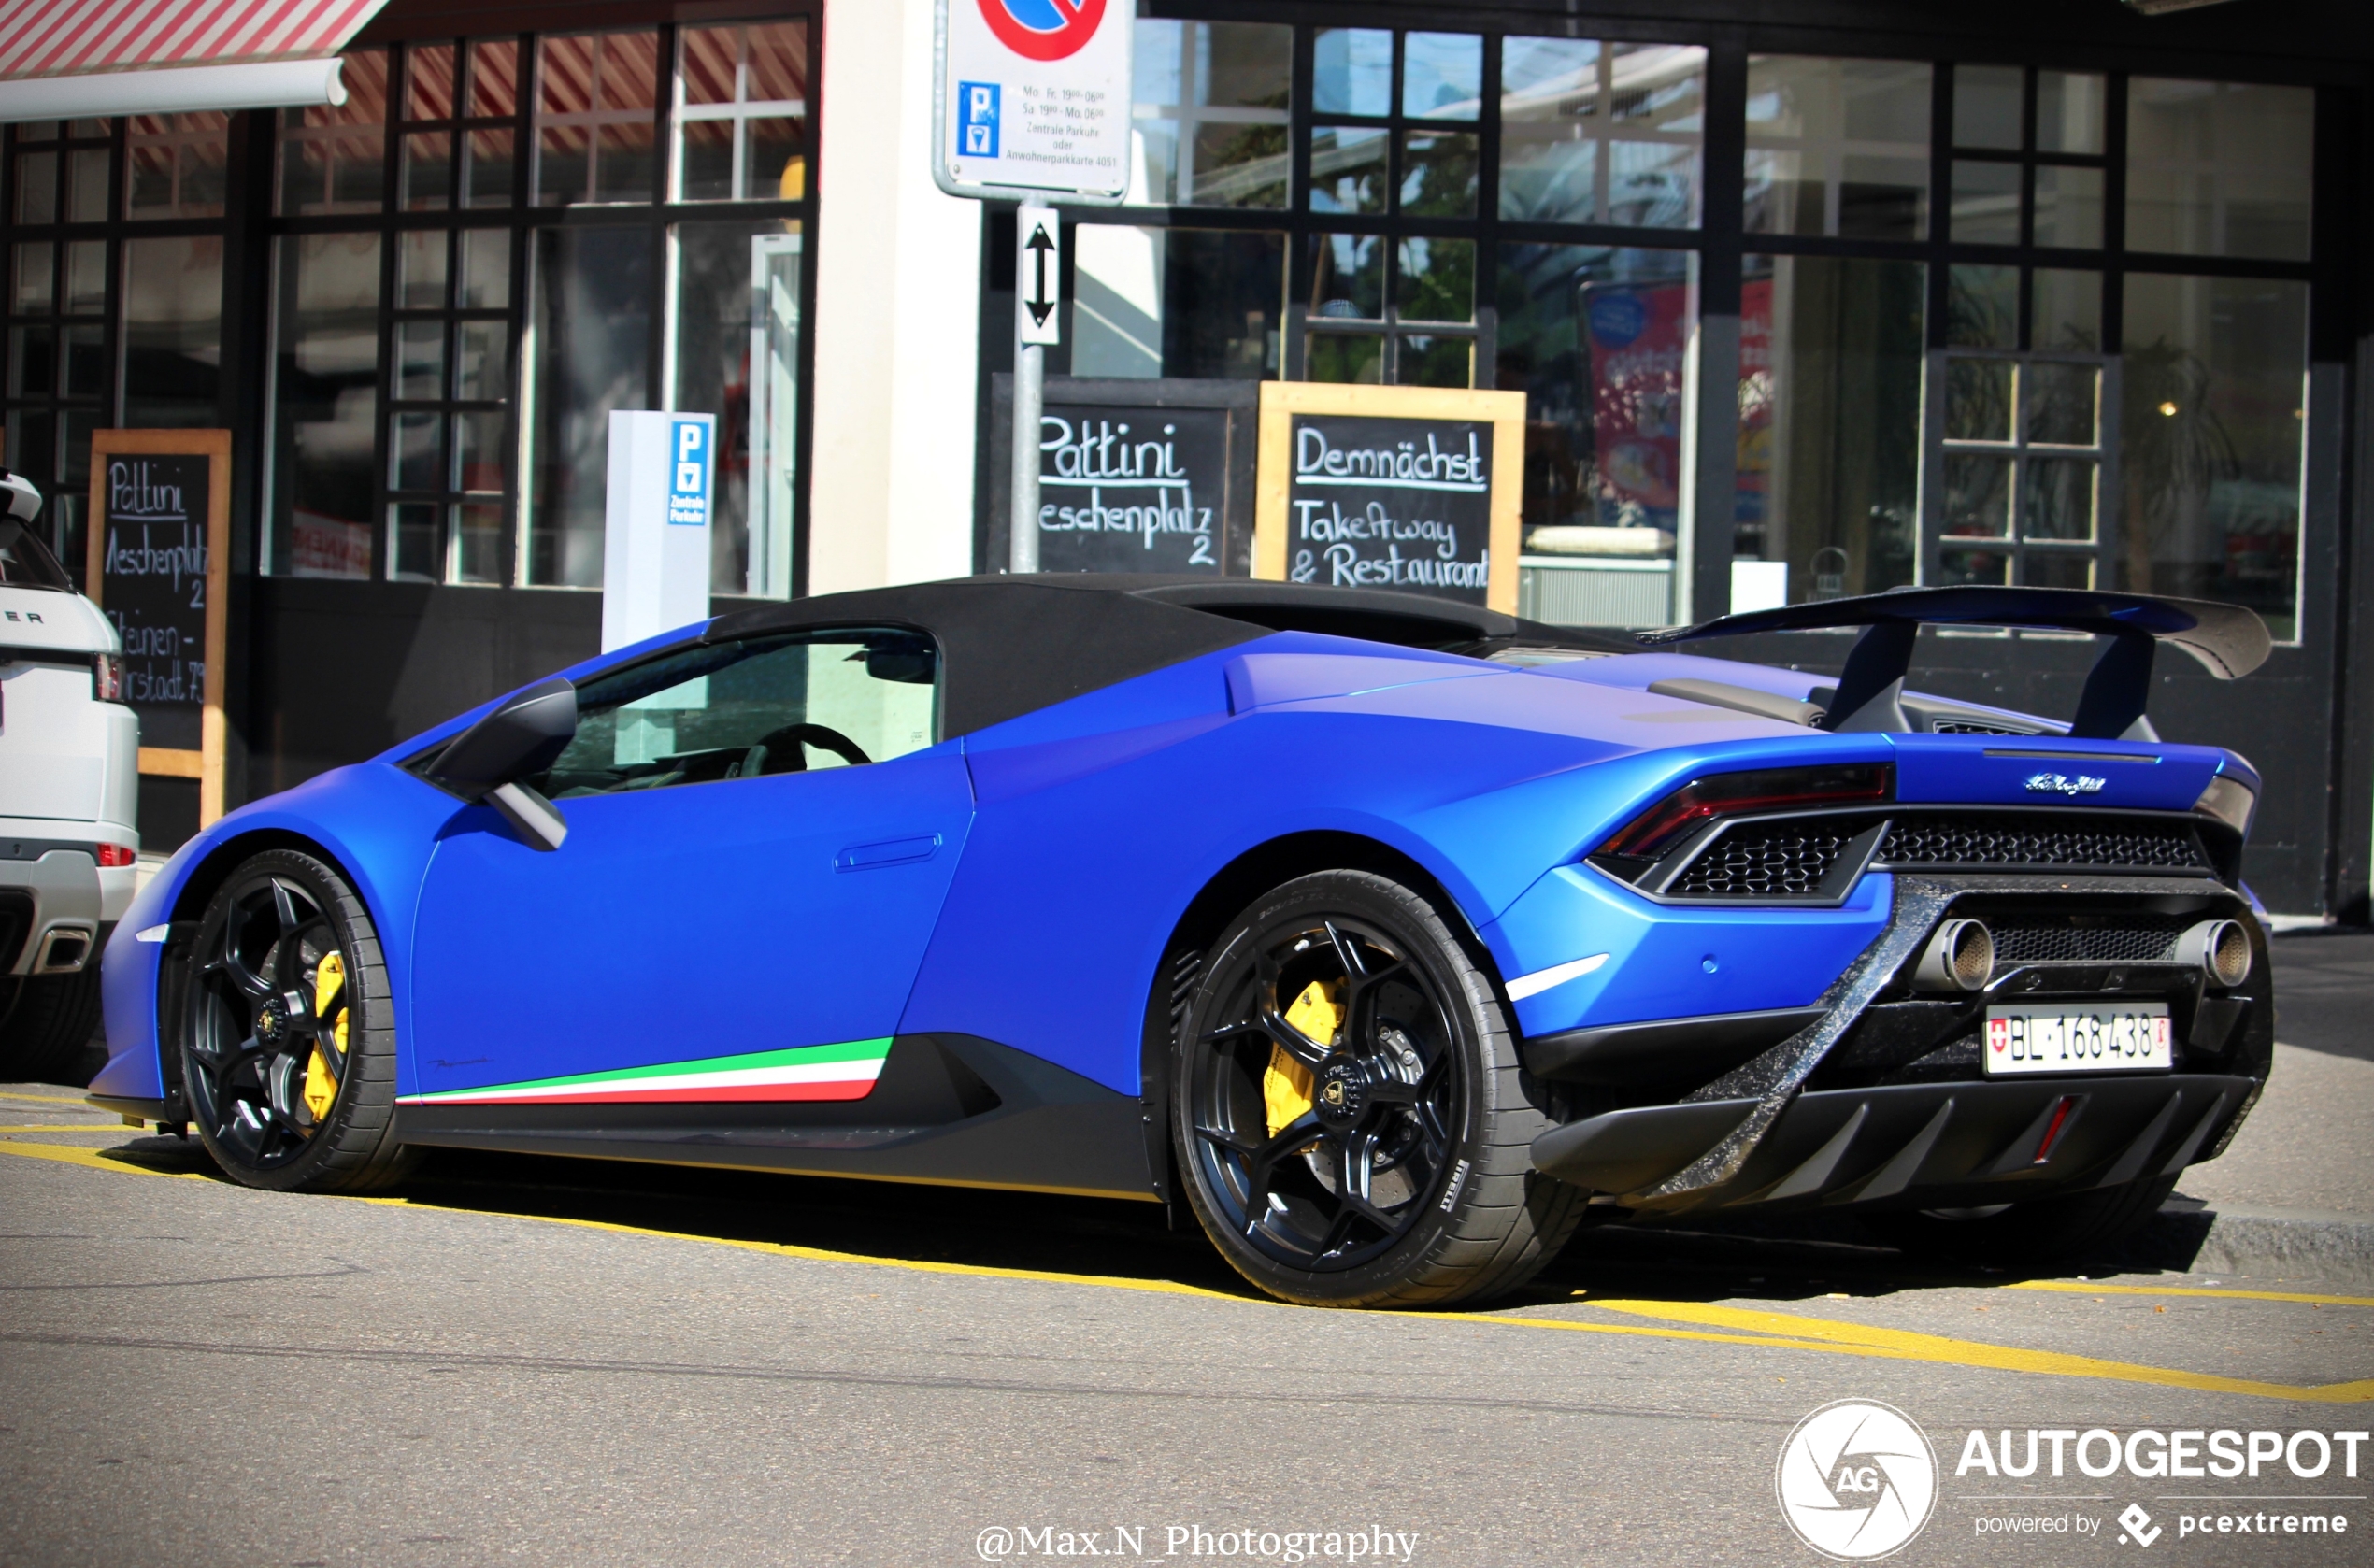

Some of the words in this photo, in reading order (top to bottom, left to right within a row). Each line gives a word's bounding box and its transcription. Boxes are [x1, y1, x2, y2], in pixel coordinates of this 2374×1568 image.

[970, 86, 991, 123] P
[1026, 121, 1064, 135] Zentrale
[1065, 125, 1099, 138] Parkuhr
[1052, 139, 1073, 150] oder
[1006, 150, 1094, 166] Anwohnerparkkarte
[1095, 156, 1117, 167] 4051
[679, 423, 702, 463] P
[1039, 416, 1186, 478] Pattini
[1297, 427, 1486, 484] Demnächst
[109, 462, 186, 513] Pattini
[670, 494, 705, 510] Zentrale
[669, 508, 704, 523] Parkuhr
[1038, 487, 1212, 549] eschenplatz
[1188, 535, 1216, 565] 2
[1291, 549, 1317, 583] &
[1323, 543, 1489, 588] Restaurant
[190, 580, 204, 608] 2
